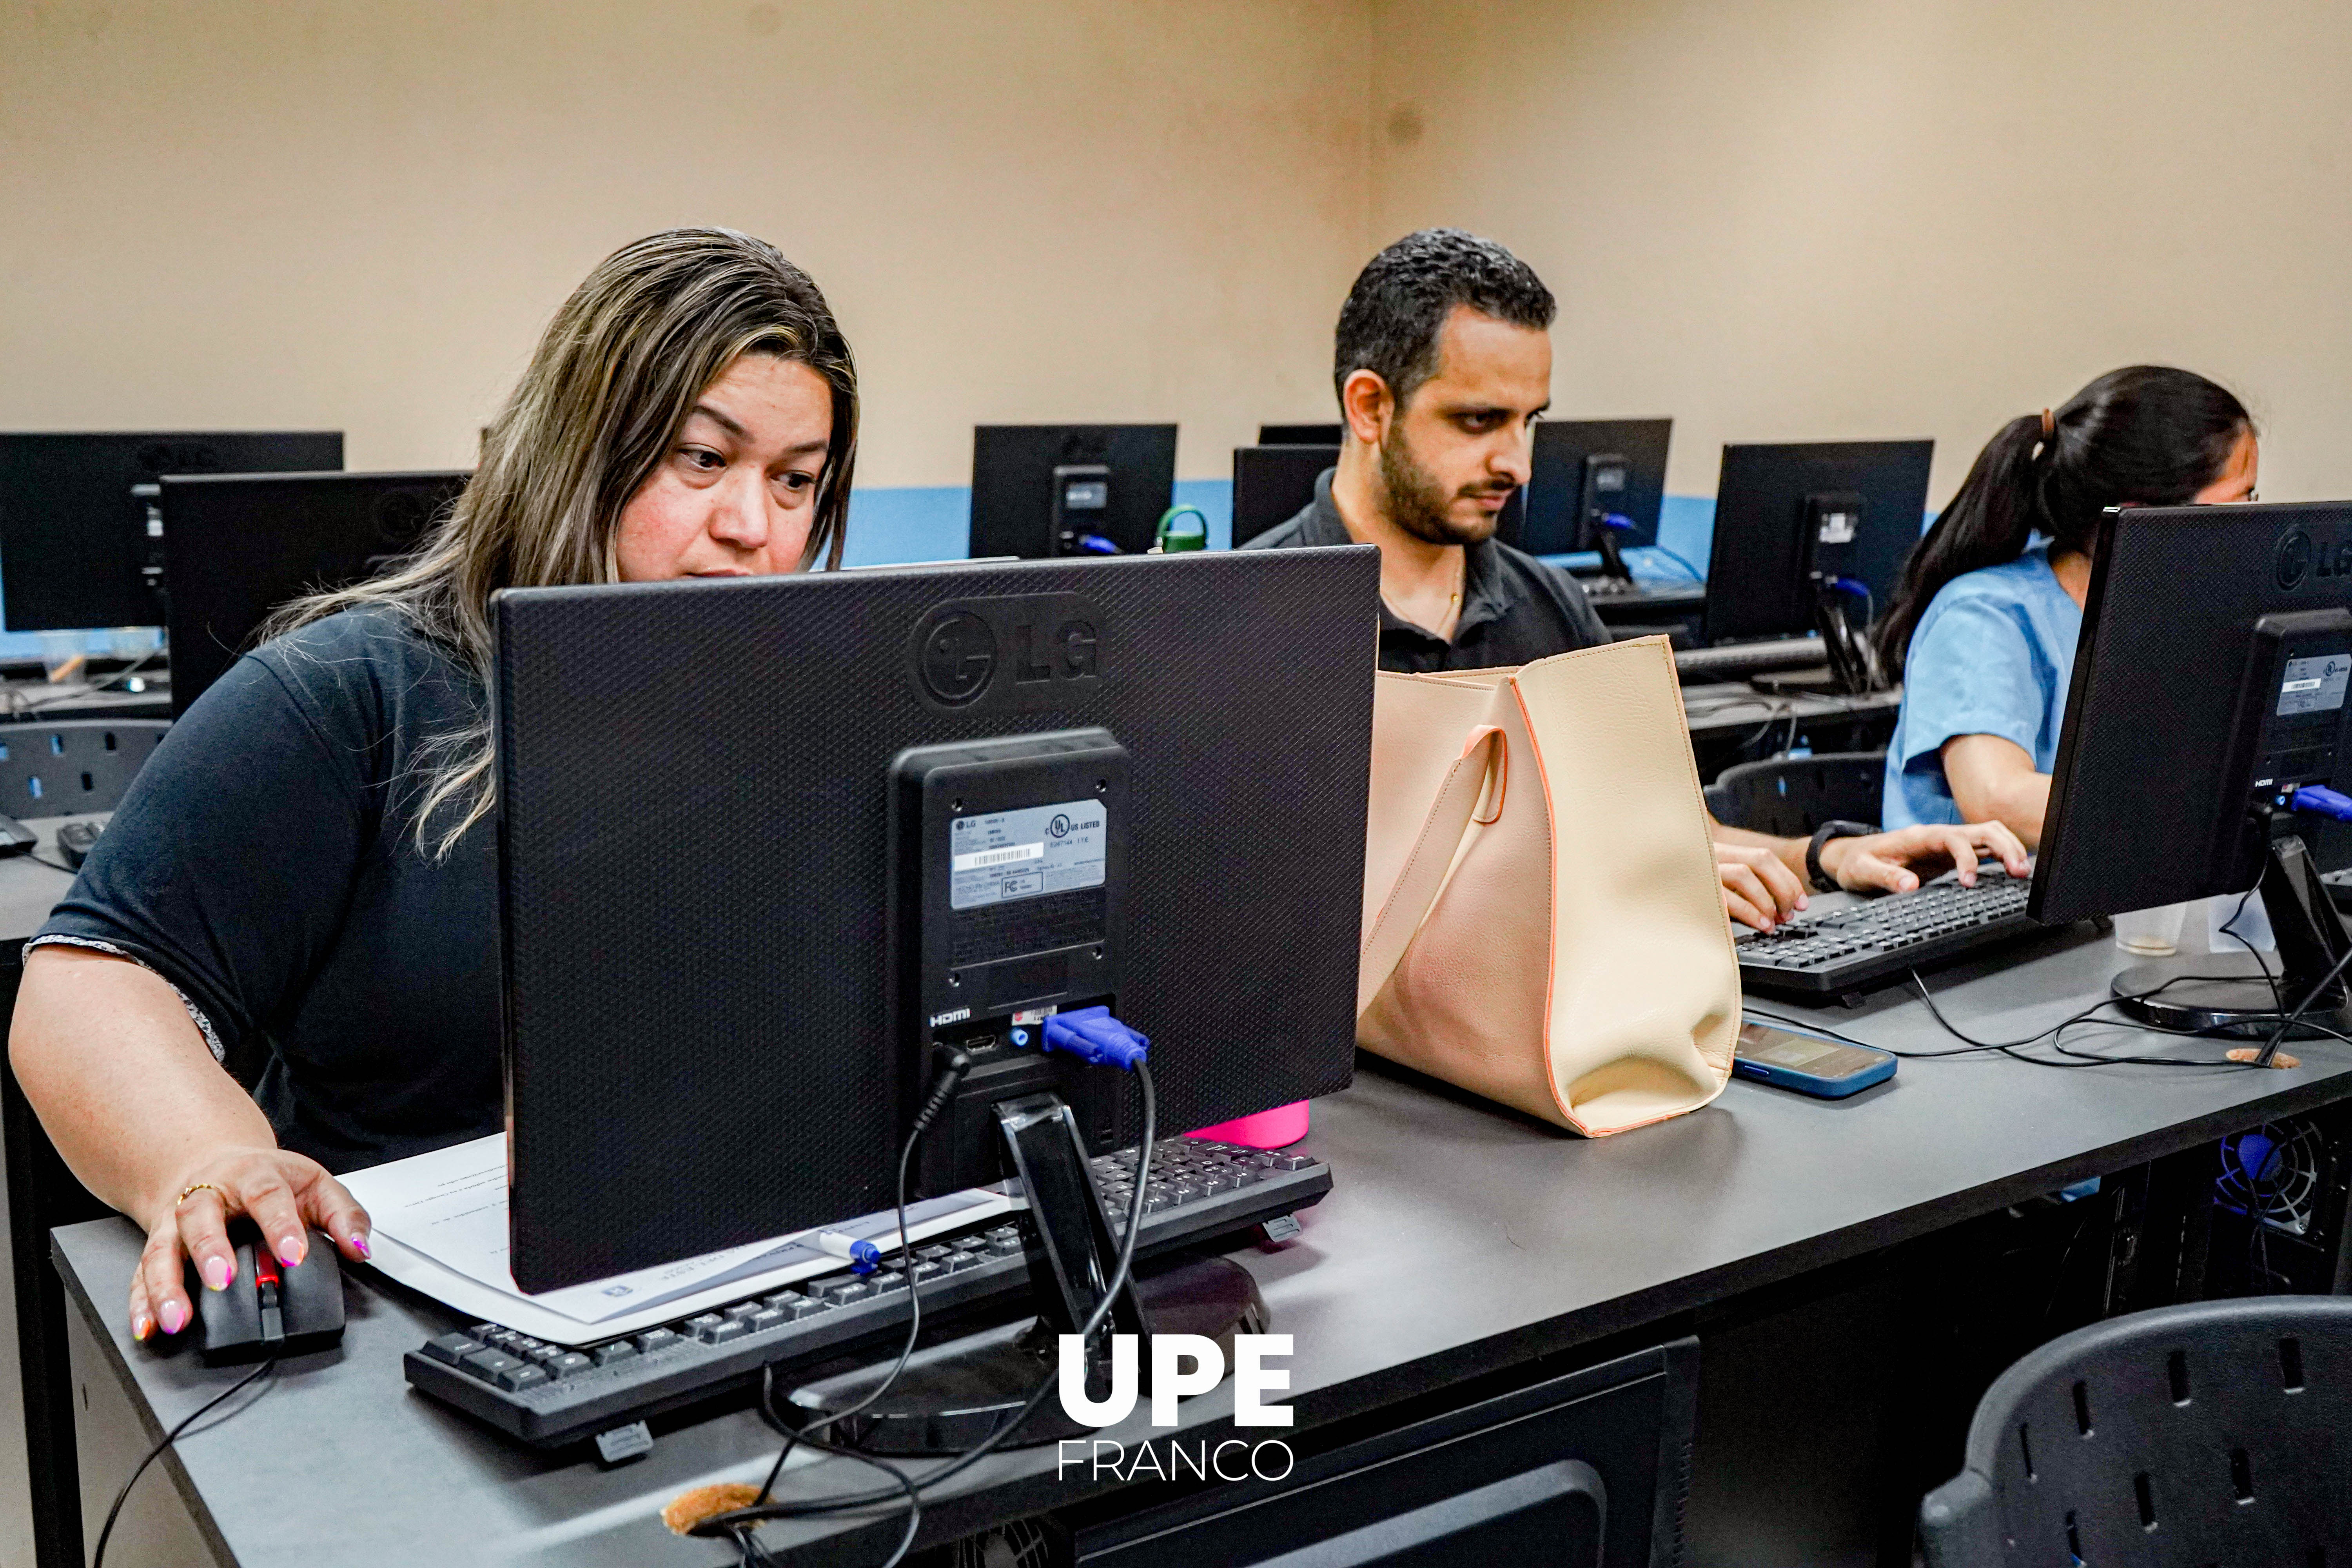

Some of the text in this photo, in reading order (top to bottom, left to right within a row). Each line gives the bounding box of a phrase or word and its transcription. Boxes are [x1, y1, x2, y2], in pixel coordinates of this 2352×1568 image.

[1018, 619, 1096, 684] LG
[2255, 779, 2273, 787] HDMI
[966, 820, 976, 828] LG
[1081, 820, 1100, 829] LISTED
[930, 1008, 970, 1027] HDMI
